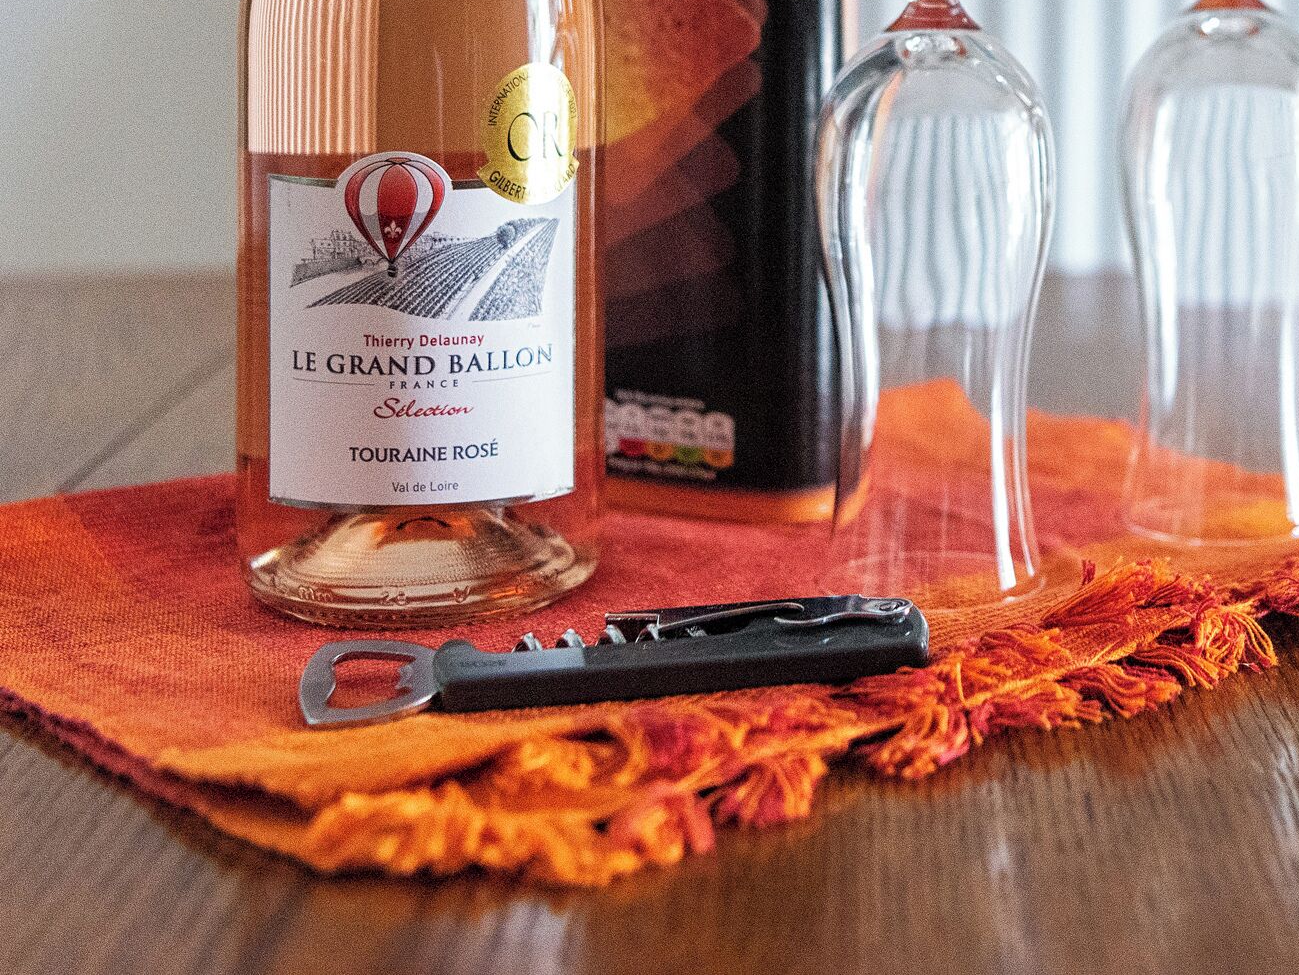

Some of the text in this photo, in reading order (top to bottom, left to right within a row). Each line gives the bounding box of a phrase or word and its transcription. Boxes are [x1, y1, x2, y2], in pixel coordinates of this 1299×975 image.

[507, 111, 567, 162] OR
[489, 170, 527, 200] GILBERT
[363, 334, 485, 350] Thierry Delaunay
[292, 343, 553, 376] LE GRAND BALLON
[389, 379, 459, 389] FRANCE
[349, 438, 499, 463] TOURAINE ROSÉ
[391, 481, 460, 493] Val de Loire
